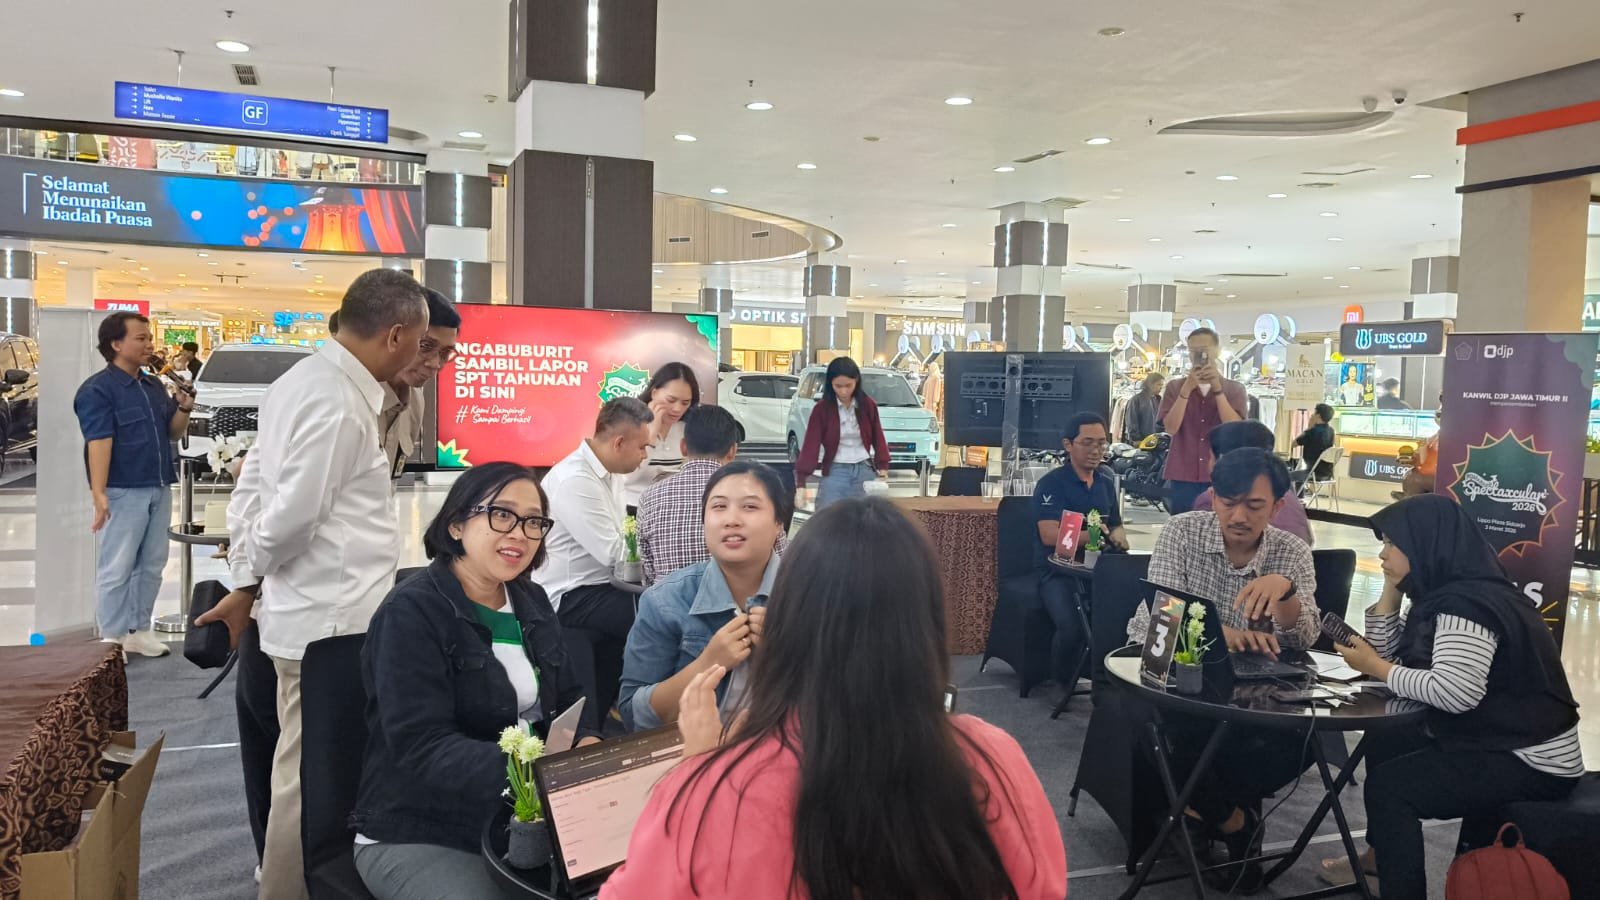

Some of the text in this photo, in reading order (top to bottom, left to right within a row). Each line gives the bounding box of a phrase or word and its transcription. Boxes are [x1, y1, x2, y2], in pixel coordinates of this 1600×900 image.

[244, 105, 264, 119] GF
[42, 175, 109, 194] Selamat
[43, 190, 146, 212] Menunaikan
[43, 206, 152, 227] Ibadah Puasa
[741, 309, 785, 323] OPTIK
[903, 320, 966, 336] SAMSUN
[1374, 332, 1428, 344] UBS GOLD
[455, 342, 574, 358] NGABUBURIT
[455, 357, 588, 373] SAMBIL LAPOR
[455, 371, 581, 386] SPT TAHUNAN
[1287, 369, 1323, 378] MACAN
[455, 386, 515, 399] DI SINI
[1463, 392, 1492, 400] KANWIL
[470, 405, 490, 414] Kami
[491, 405, 526, 416] Dampingi
[472, 414, 532, 425] Sampai Berhasil
[1380, 465, 1396, 474] UBS
[1512, 502, 1536, 512] 2026
[1062, 530, 1073, 550] 4
[1150, 623, 1169, 657] 3
